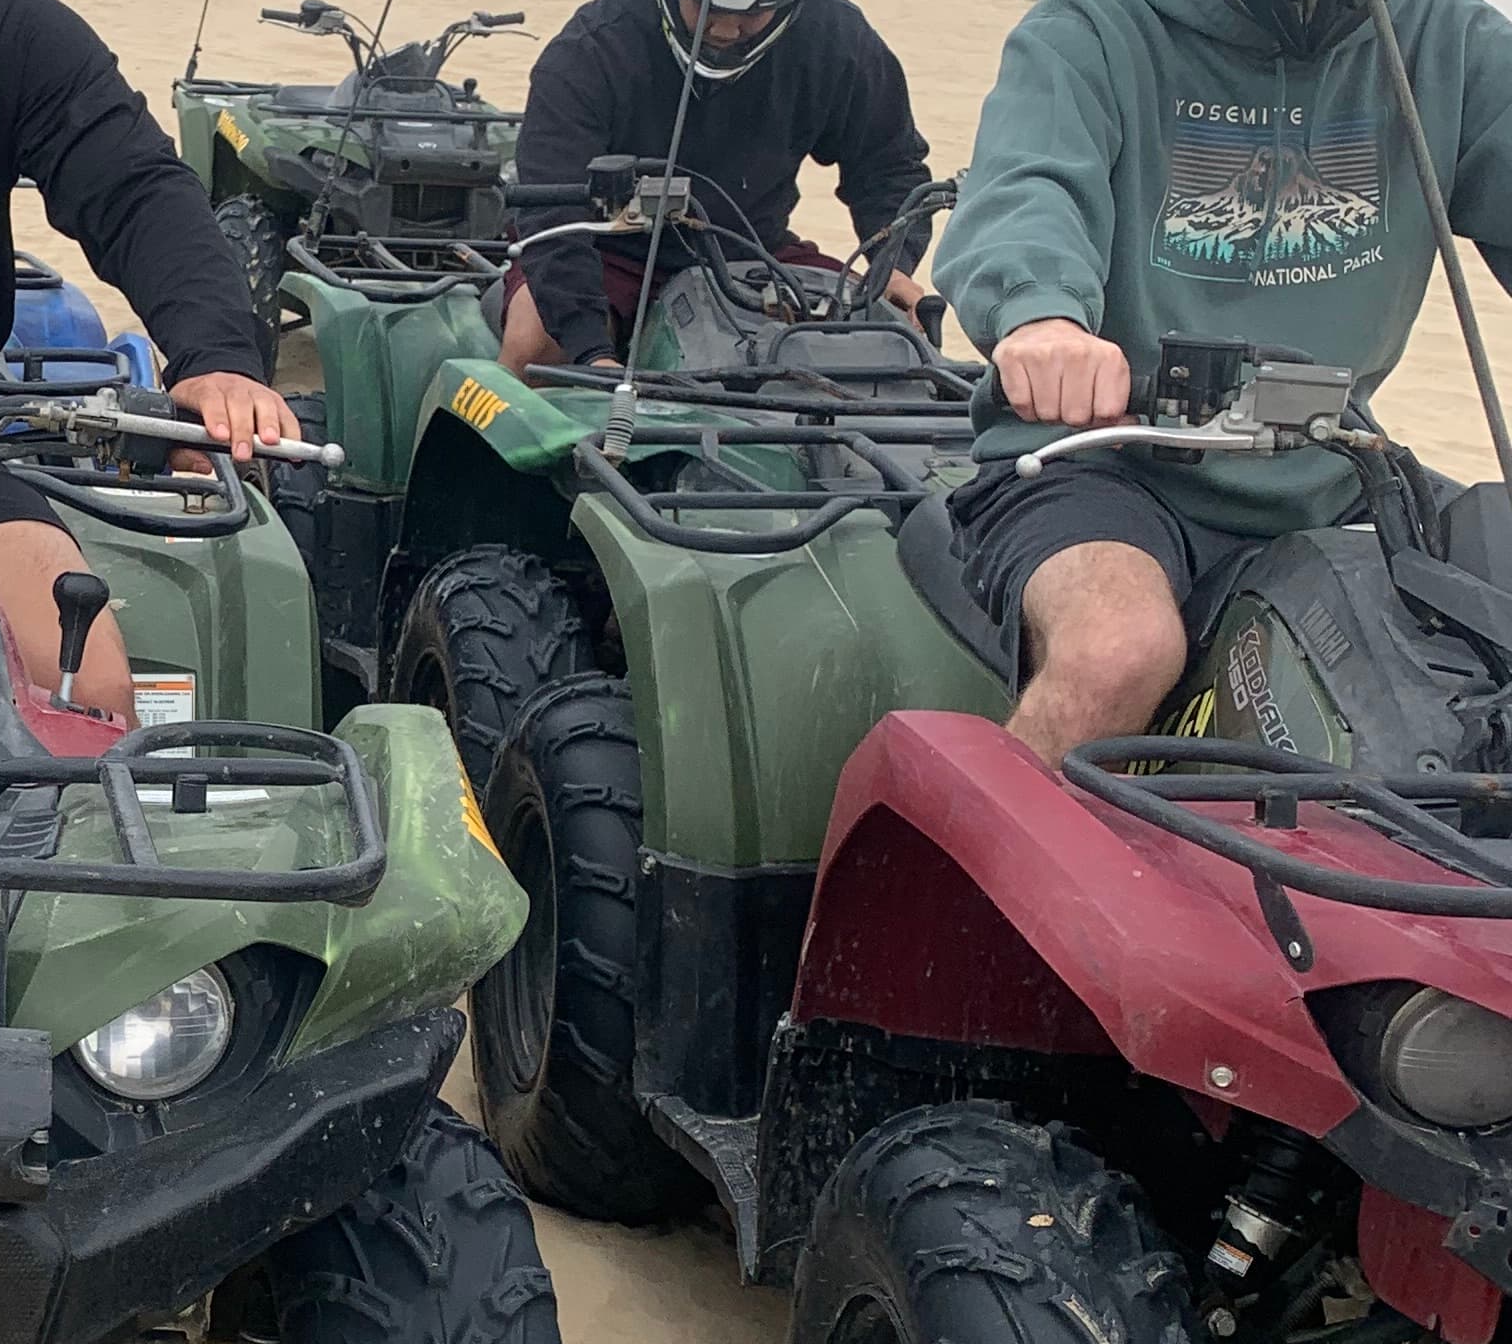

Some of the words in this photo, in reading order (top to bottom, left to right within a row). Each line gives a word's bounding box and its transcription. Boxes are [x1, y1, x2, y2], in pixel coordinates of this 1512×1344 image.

[1254, 263, 1337, 288] NATIONAL
[1343, 245, 1385, 275] PARK
[450, 376, 511, 432] ELVIS
[1299, 599, 1352, 668] YAMAHA
[1227, 645, 1249, 712] 450
[1238, 616, 1299, 754] KODIAK
